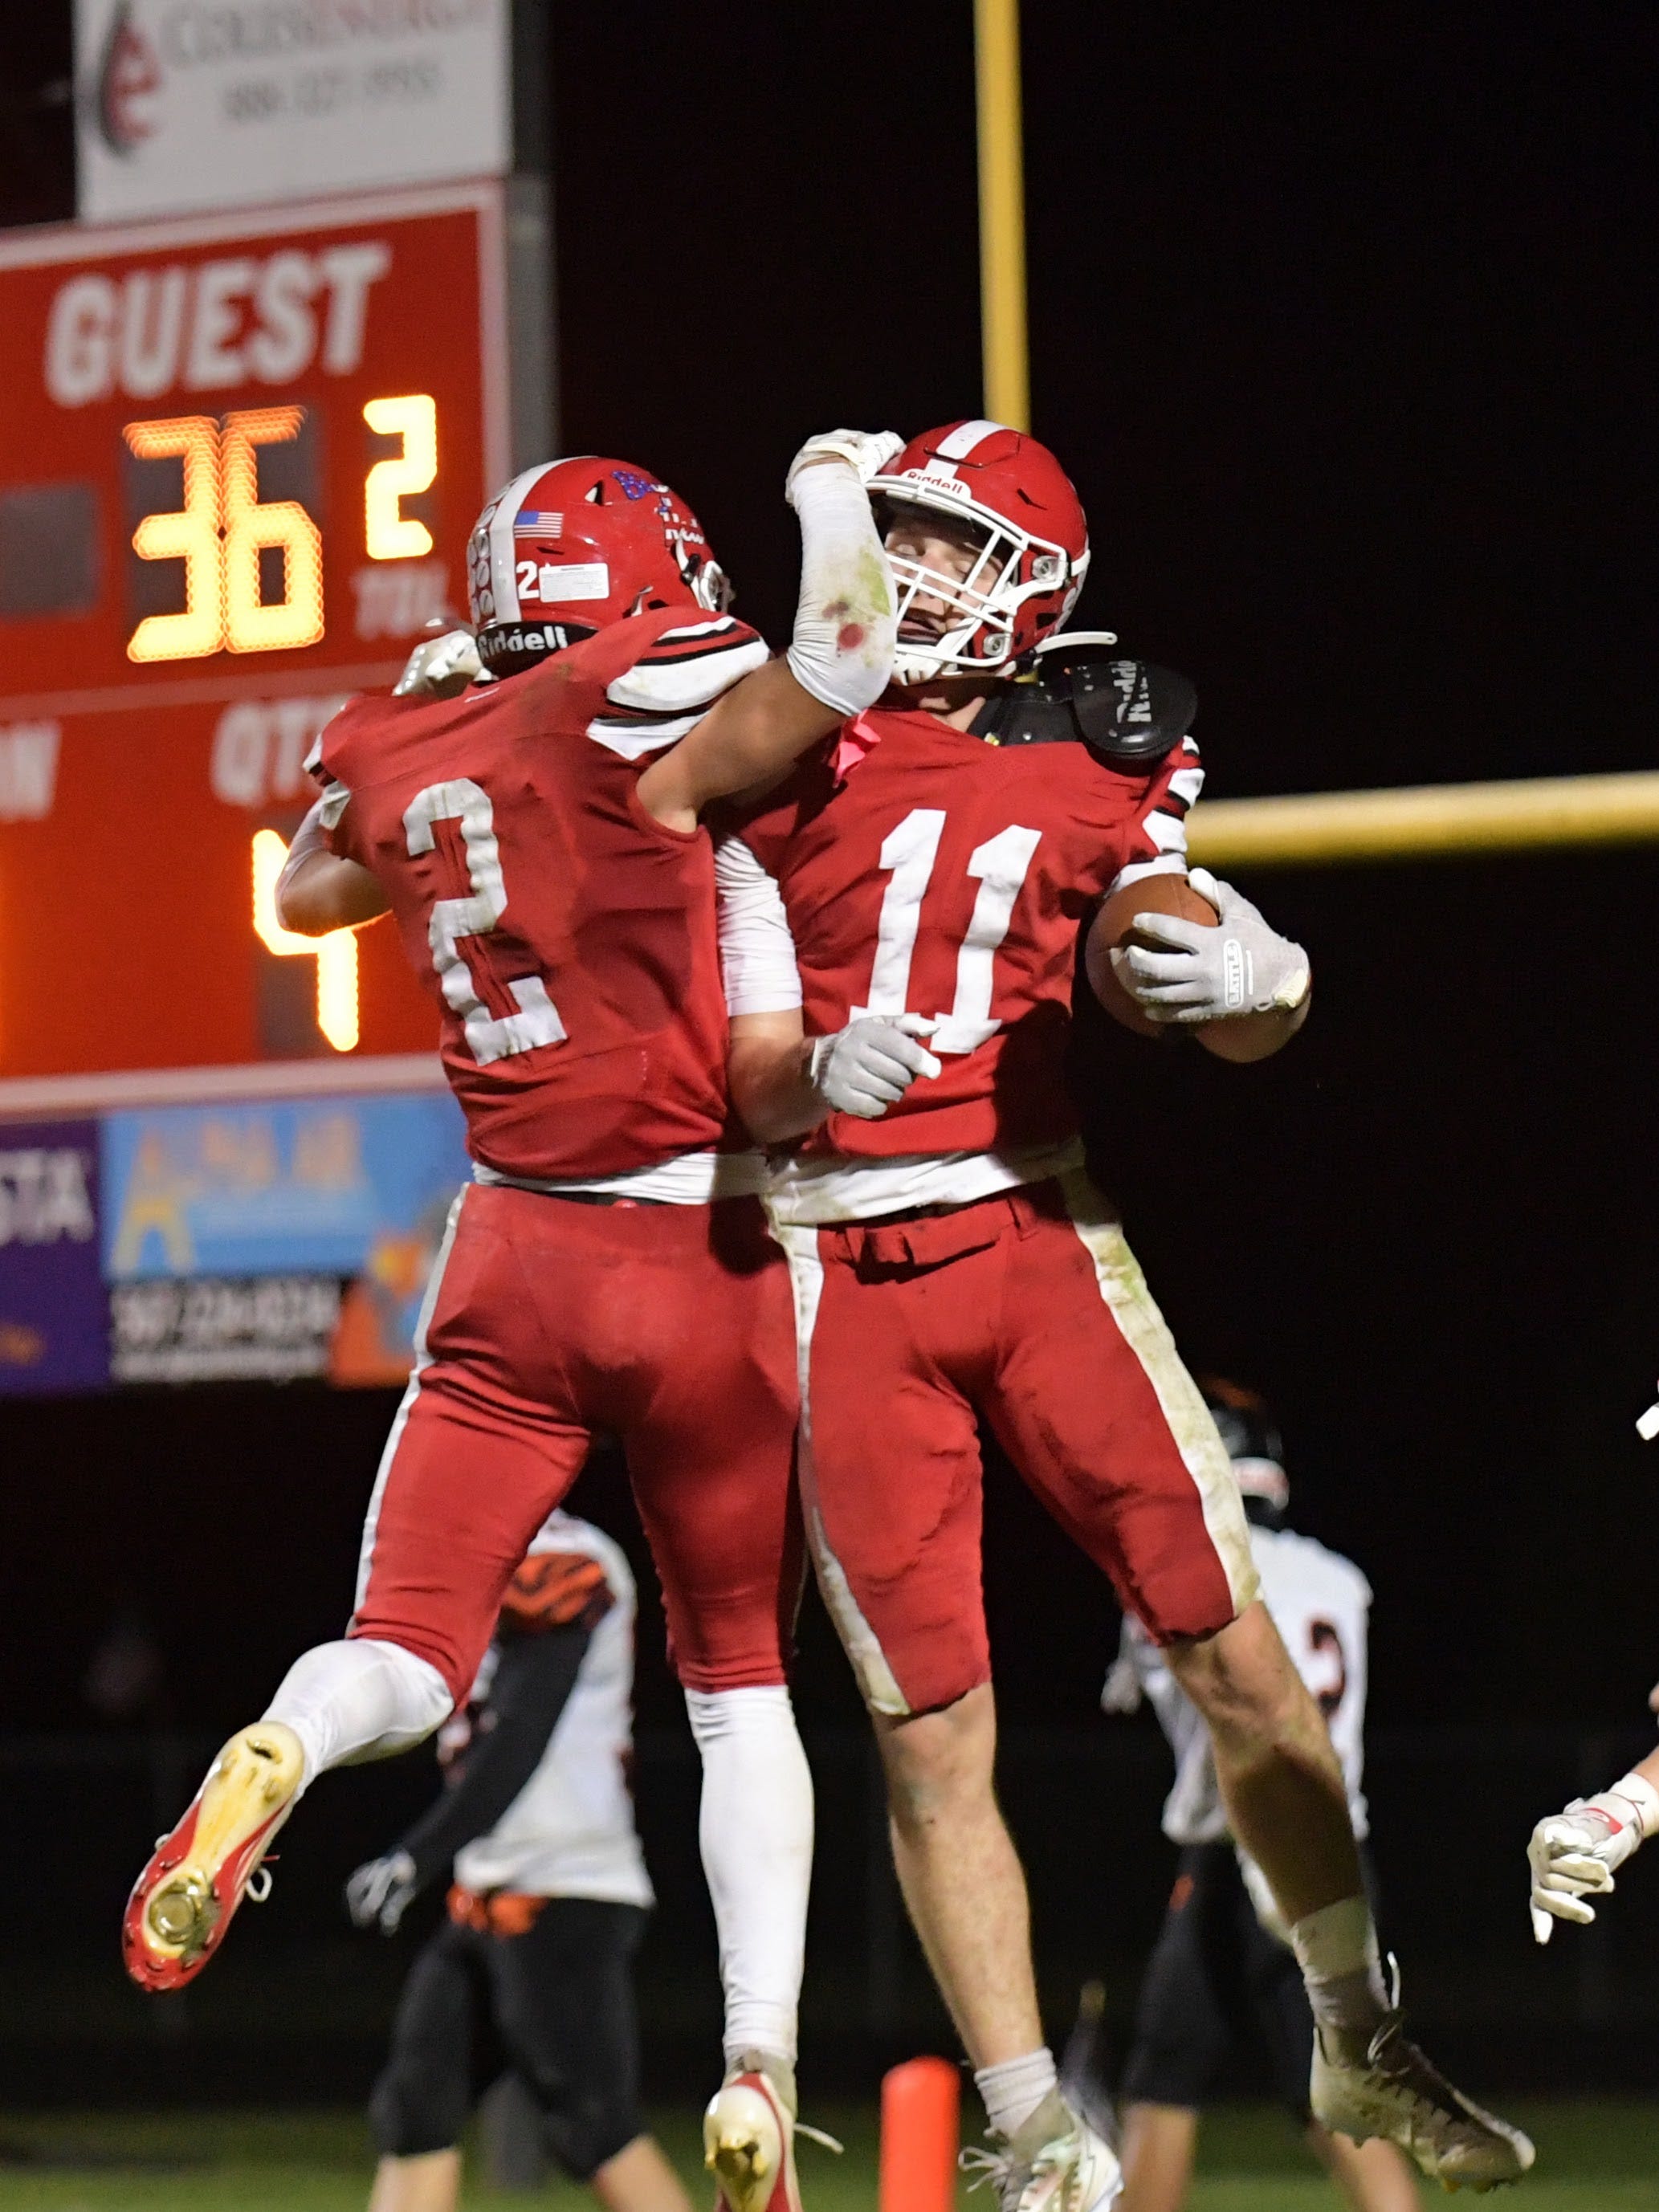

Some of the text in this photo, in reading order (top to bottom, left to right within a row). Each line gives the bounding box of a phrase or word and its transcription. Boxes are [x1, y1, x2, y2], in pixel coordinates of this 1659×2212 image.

[46, 242, 391, 406] GUEST
[122, 405, 324, 662] 36
[364, 394, 438, 560] 2
[907, 471, 963, 494] Riddell
[477, 625, 569, 659] Riddell
[210, 695, 353, 809] QT
[251, 829, 359, 1052] 4
[402, 777, 568, 1067] 2
[848, 809, 1043, 1055] 11
